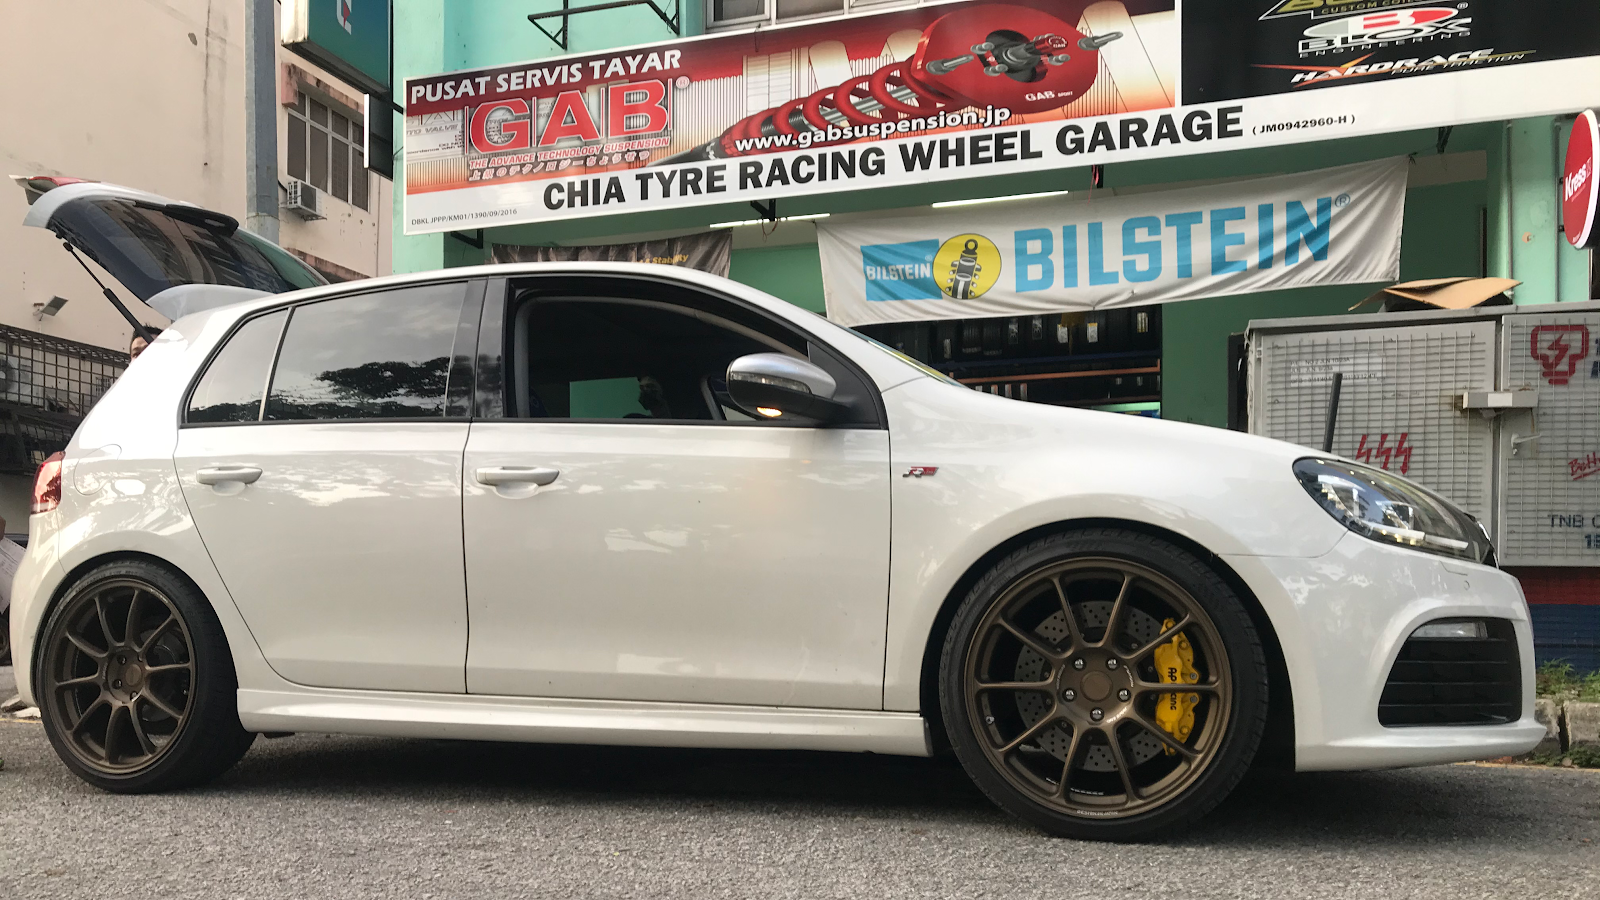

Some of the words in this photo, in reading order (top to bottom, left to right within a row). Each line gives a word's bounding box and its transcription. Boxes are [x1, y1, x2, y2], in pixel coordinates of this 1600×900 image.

[1321, 1, 1378, 15] CUSTOM
[1300, 30, 1471, 58] ENGINEERING
[411, 76, 490, 105] PUSAT
[496, 63, 582, 93] SERVIS
[589, 49, 682, 79] TAYAR
[1291, 48, 1494, 84] HARDRACE
[470, 79, 668, 154] GAB
[734, 104, 1011, 153] www.gabsuspension.jp
[469, 158, 488, 170] THE
[489, 153, 536, 168] ADVANCE
[537, 145, 602, 162] TECHNOLOGY
[603, 137, 670, 153] SUSPENSION
[543, 172, 626, 210] CHIA
[635, 163, 727, 202] TYRE
[738, 145, 886, 191] RACING
[900, 129, 1043, 173] WHEEL
[1055, 106, 1243, 156] GARAGE
[1565, 162, 1587, 202] Kress
[411, 218, 429, 226] DBKL
[430, 208, 518, 224] JPPP/KM01/1390/09/2016
[866, 262, 931, 281] BILSTEIN
[1014, 196, 1332, 294] BILSTEIN
[1547, 514, 1584, 528] TNB
[1168, 667, 1177, 682] AP
